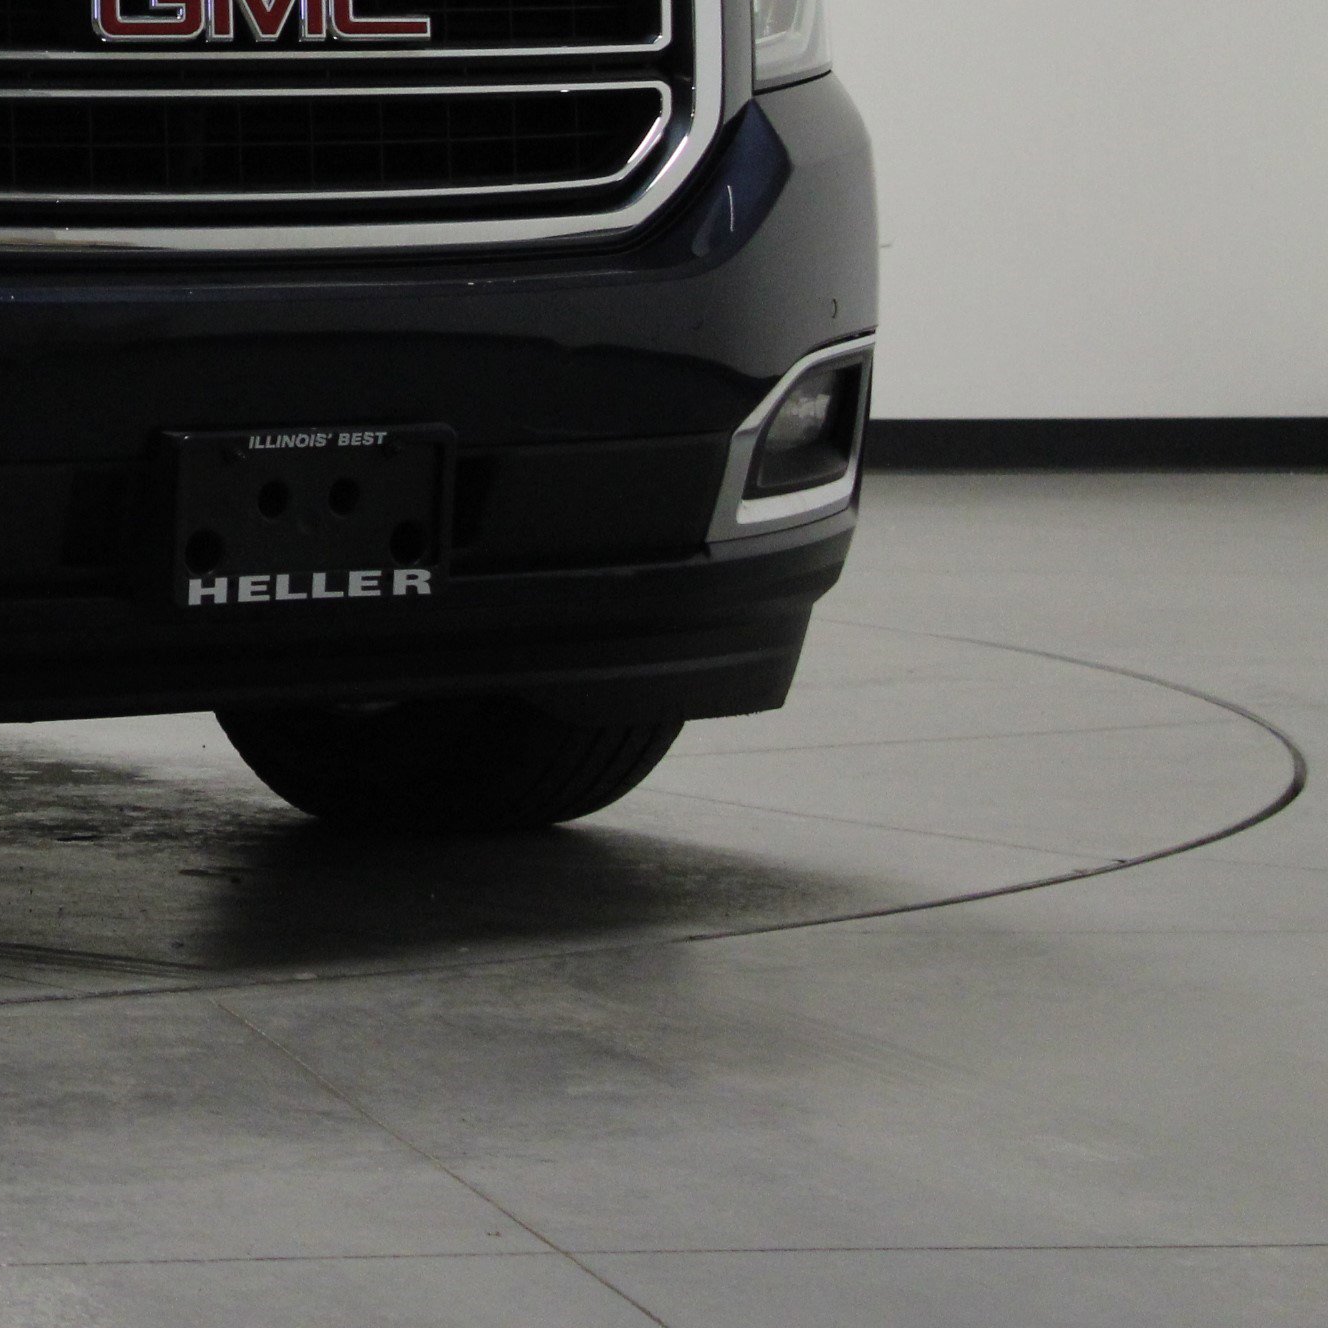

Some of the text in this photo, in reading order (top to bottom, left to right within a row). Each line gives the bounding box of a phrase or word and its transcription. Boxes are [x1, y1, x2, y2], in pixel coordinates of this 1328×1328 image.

[248, 431, 387, 450] ILLINOIS' BEST
[188, 569, 432, 606] HELLER
